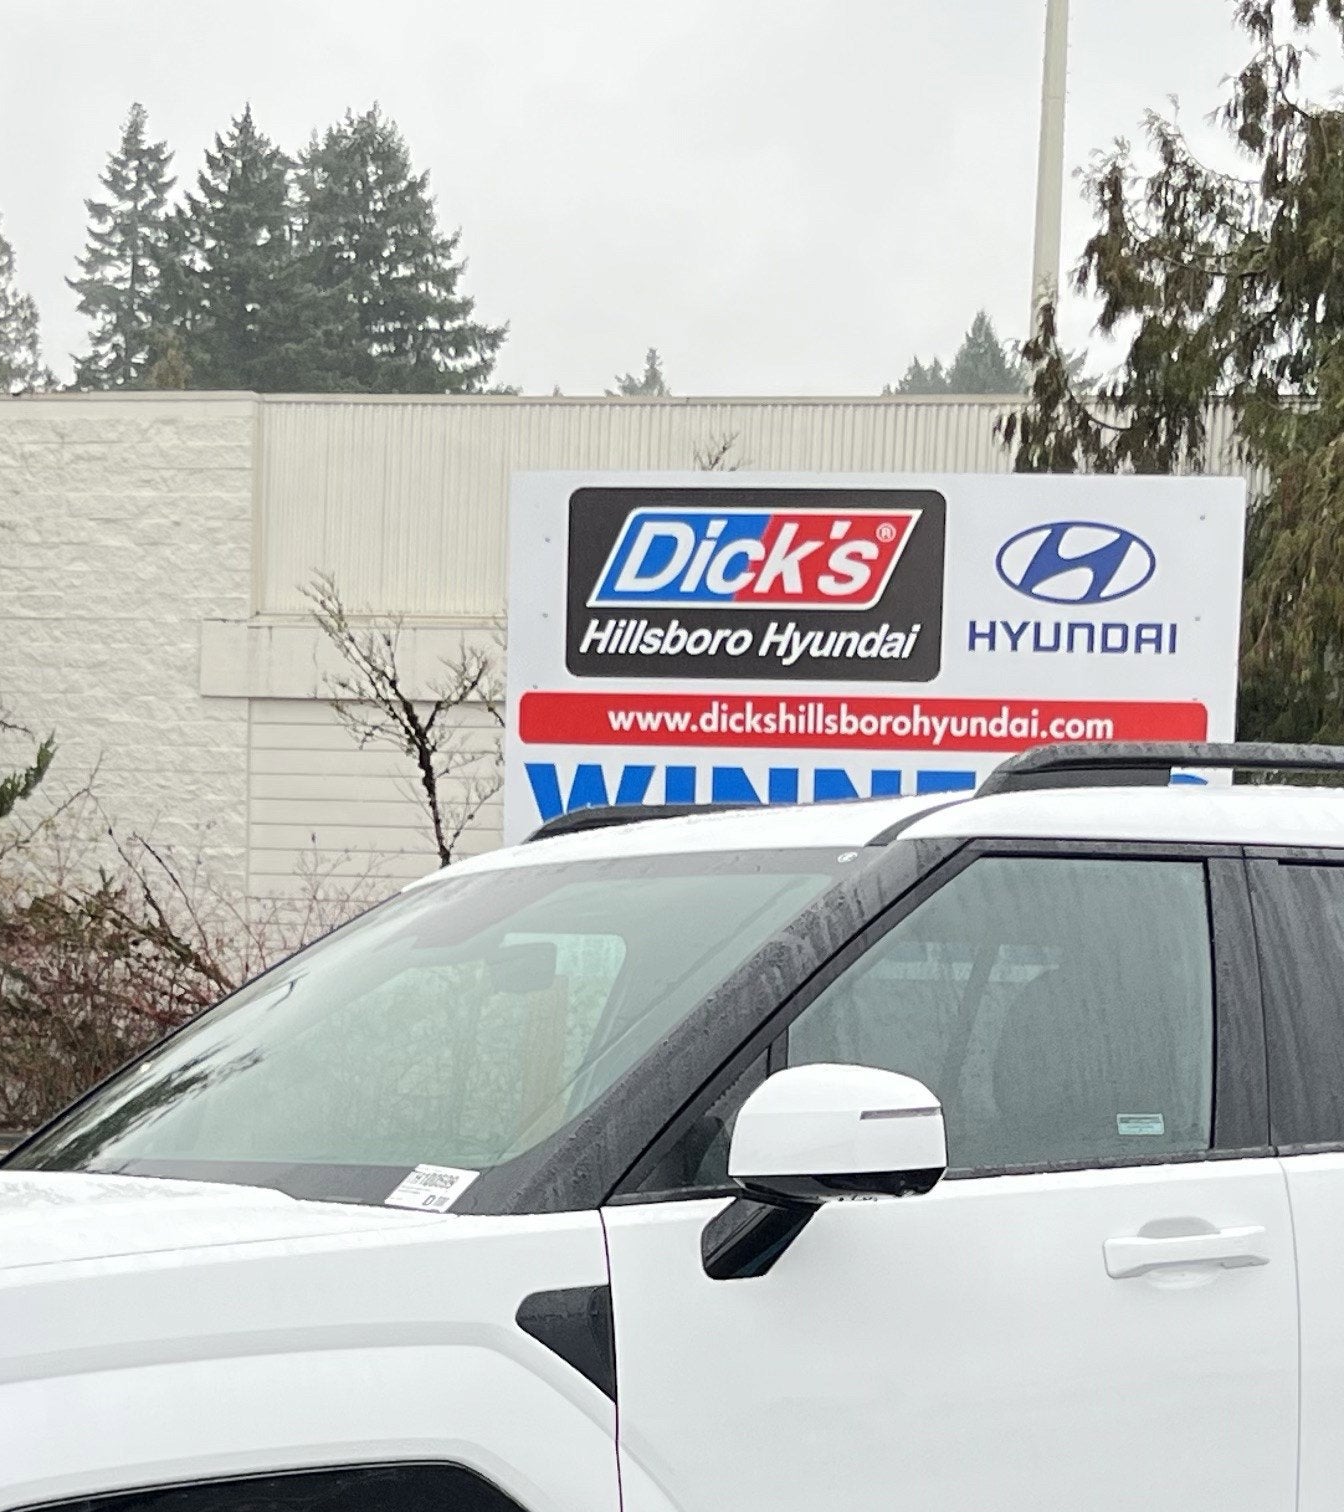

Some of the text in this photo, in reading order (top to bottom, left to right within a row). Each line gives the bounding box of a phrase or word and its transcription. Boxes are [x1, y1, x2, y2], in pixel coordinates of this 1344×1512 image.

[579, 618, 922, 667] Hillsboro Hyundai
[968, 620, 1178, 655] HYUNDAI
[608, 700, 1114, 746] www.dickshillsborohyundai.com
